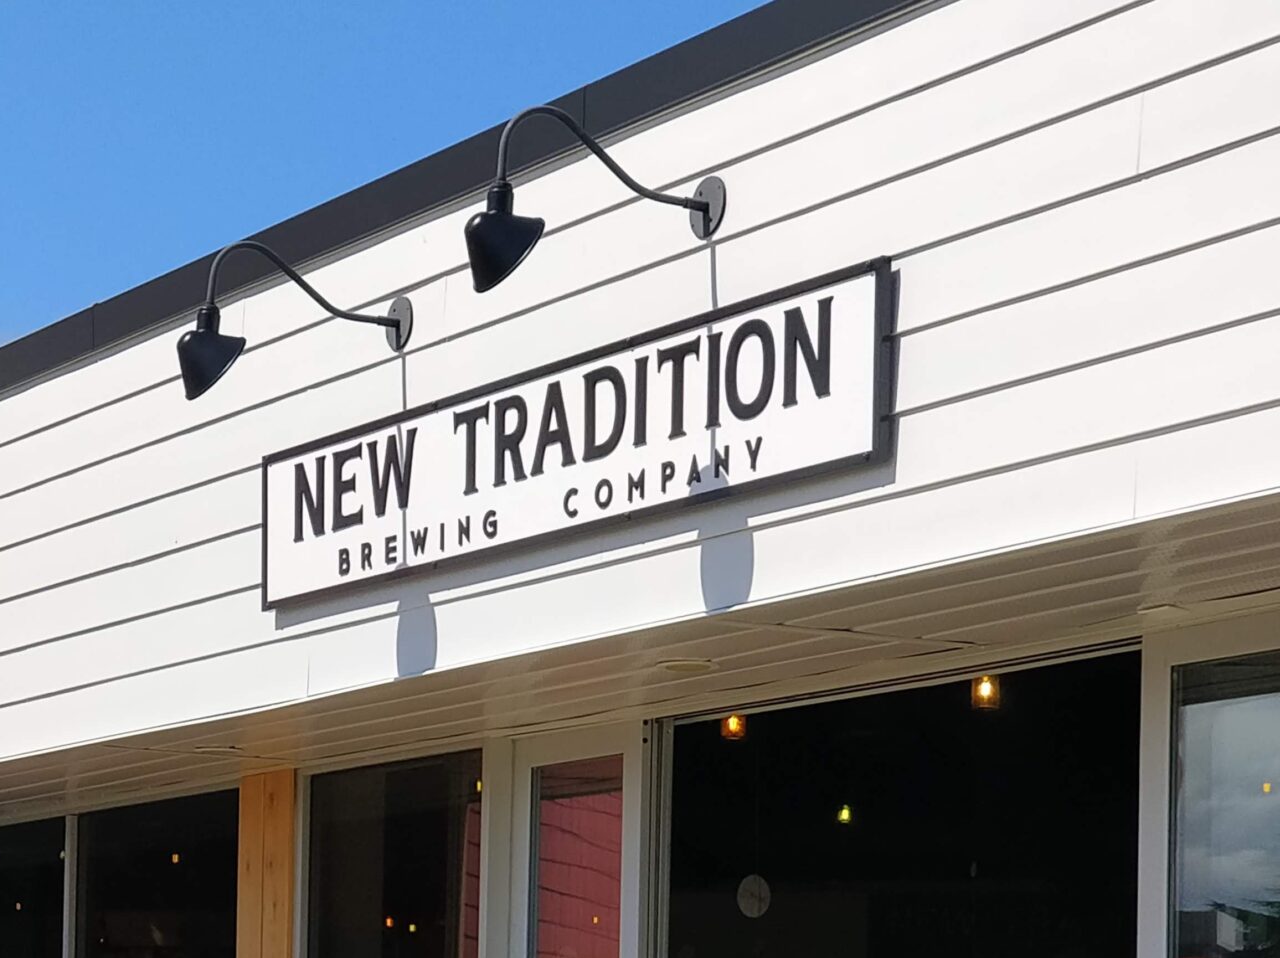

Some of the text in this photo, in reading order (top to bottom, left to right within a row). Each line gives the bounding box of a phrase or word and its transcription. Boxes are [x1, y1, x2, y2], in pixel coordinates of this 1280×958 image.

[293, 296, 834, 543] NEW TRADITION
[338, 436, 765, 576] BREWING COMPANY
